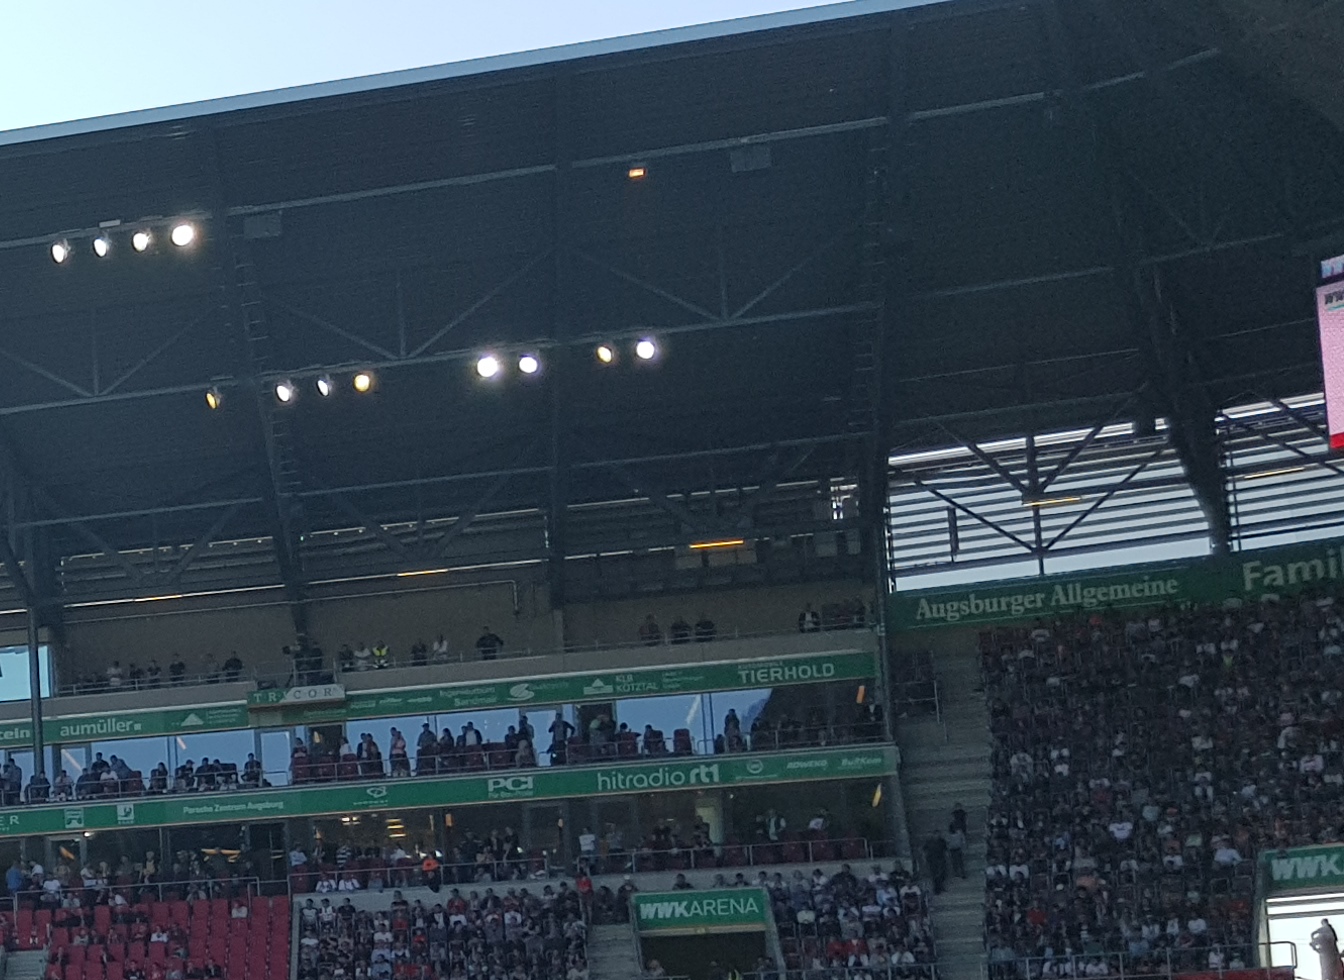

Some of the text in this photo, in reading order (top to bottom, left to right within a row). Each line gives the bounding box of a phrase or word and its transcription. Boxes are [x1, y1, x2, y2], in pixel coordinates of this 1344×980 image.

[916, 576, 1178, 621] Augsburger Allgemeine
[738, 663, 835, 684] TIERHOLD
[60, 718, 133, 738] aumüller
[488, 776, 533, 791] PCI
[597, 762, 720, 791] hitradio rt1
[183, 801, 284, 814] Porsche Zentrum Augsburg
[1271, 853, 1344, 881] WWK
